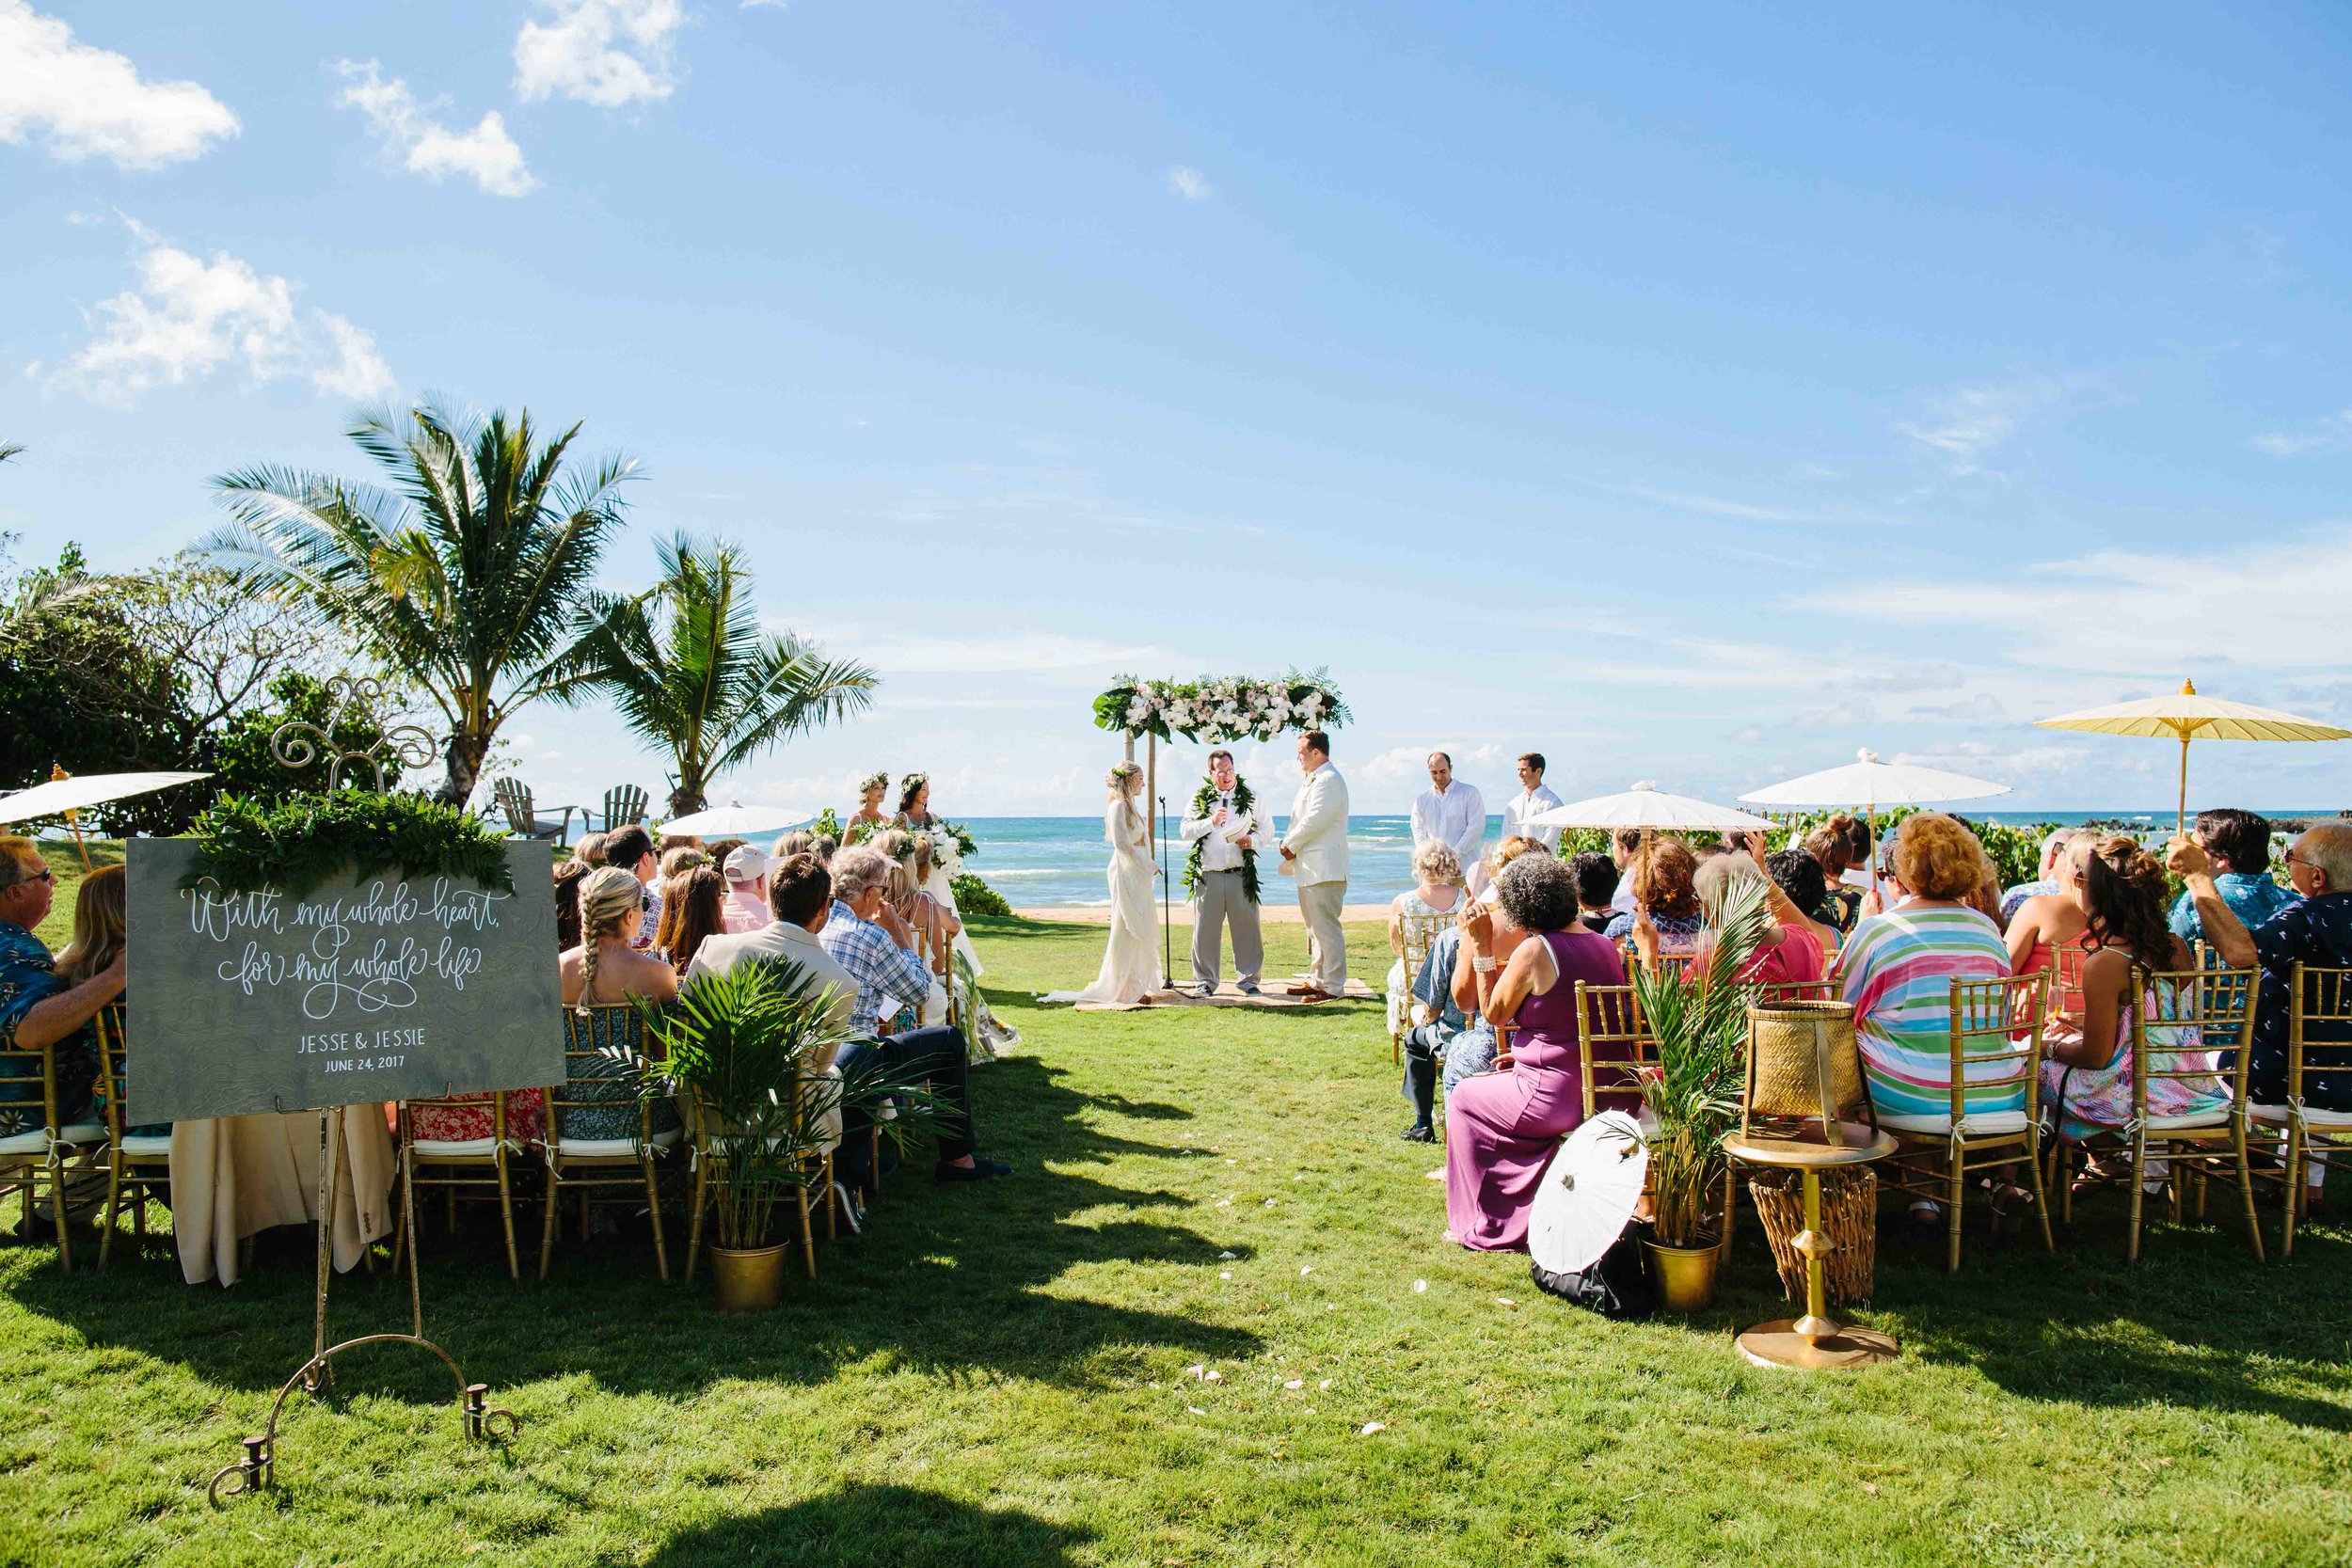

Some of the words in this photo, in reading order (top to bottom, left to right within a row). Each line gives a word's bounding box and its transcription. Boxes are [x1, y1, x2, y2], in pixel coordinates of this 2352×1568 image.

[181, 876, 284, 942] With
[291, 898, 350, 959] my
[342, 881, 418, 927] whole
[419, 876, 516, 931] heart,
[218, 941, 285, 995] for
[343, 937, 427, 986] whole
[430, 936, 482, 990] life.
[297, 1034, 349, 1053] JESSE
[355, 1032, 368, 1050] &
[373, 1028, 425, 1049] JESSIE
[325, 1058, 354, 1073] JUNE
[358, 1057, 374, 1072] 24,
[378, 1054, 405, 1069] 2017
